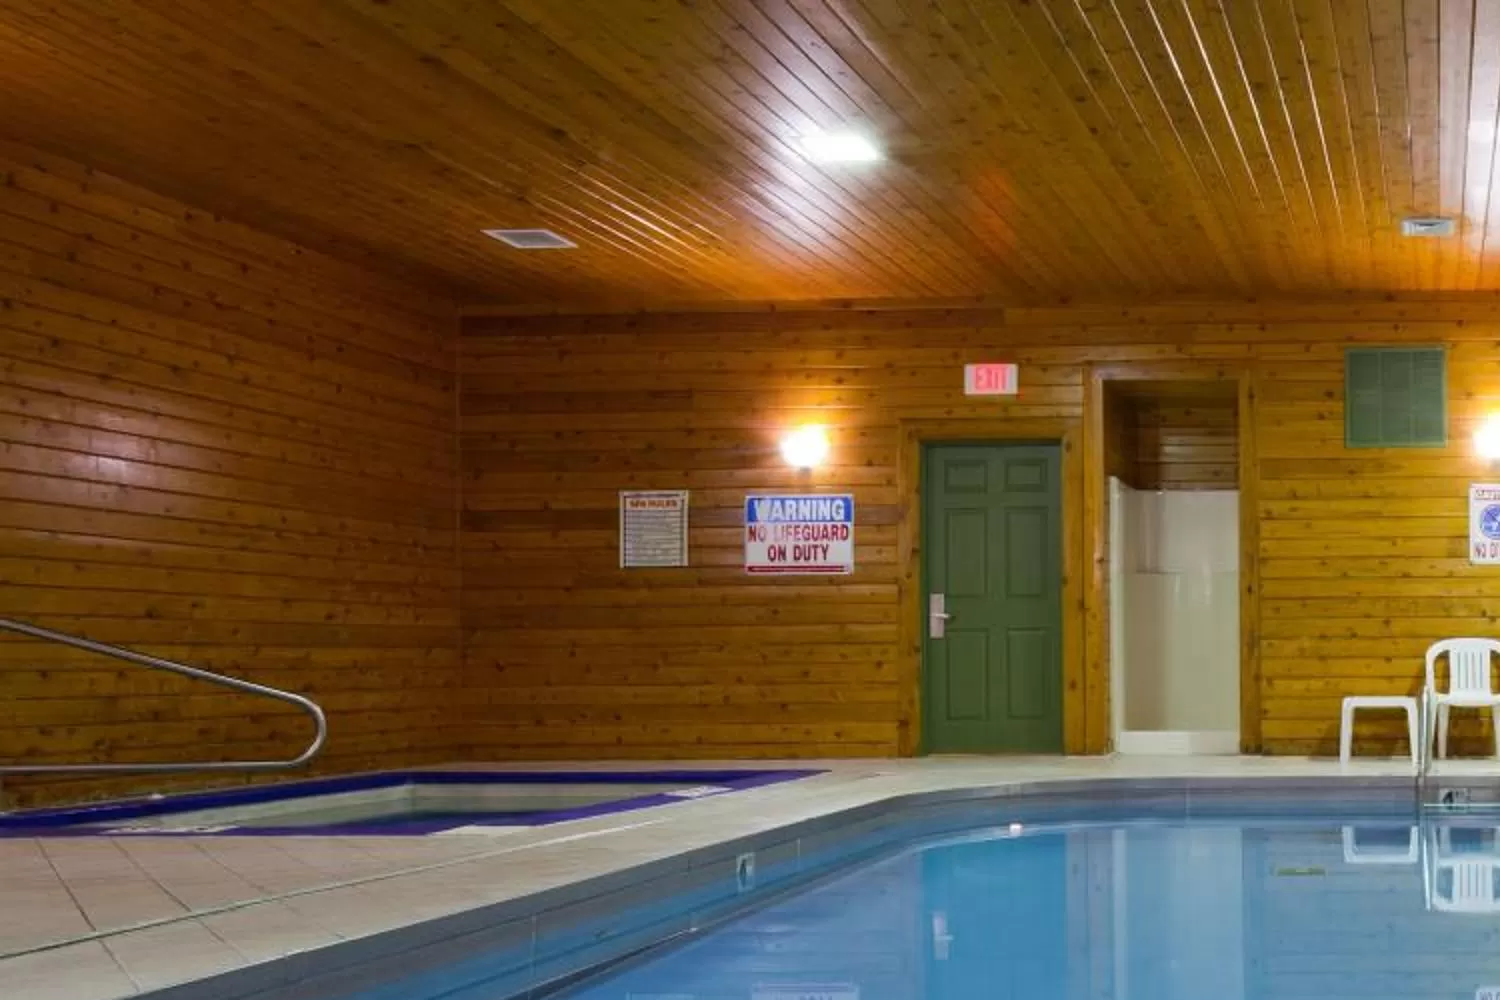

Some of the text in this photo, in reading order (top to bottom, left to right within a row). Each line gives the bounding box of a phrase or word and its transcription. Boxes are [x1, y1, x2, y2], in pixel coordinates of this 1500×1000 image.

[974, 367, 1009, 390] EXIT
[753, 499, 845, 521] WARNING
[747, 523, 849, 543] NO LIFEGUARD
[767, 543, 829, 562] ON DUTY
